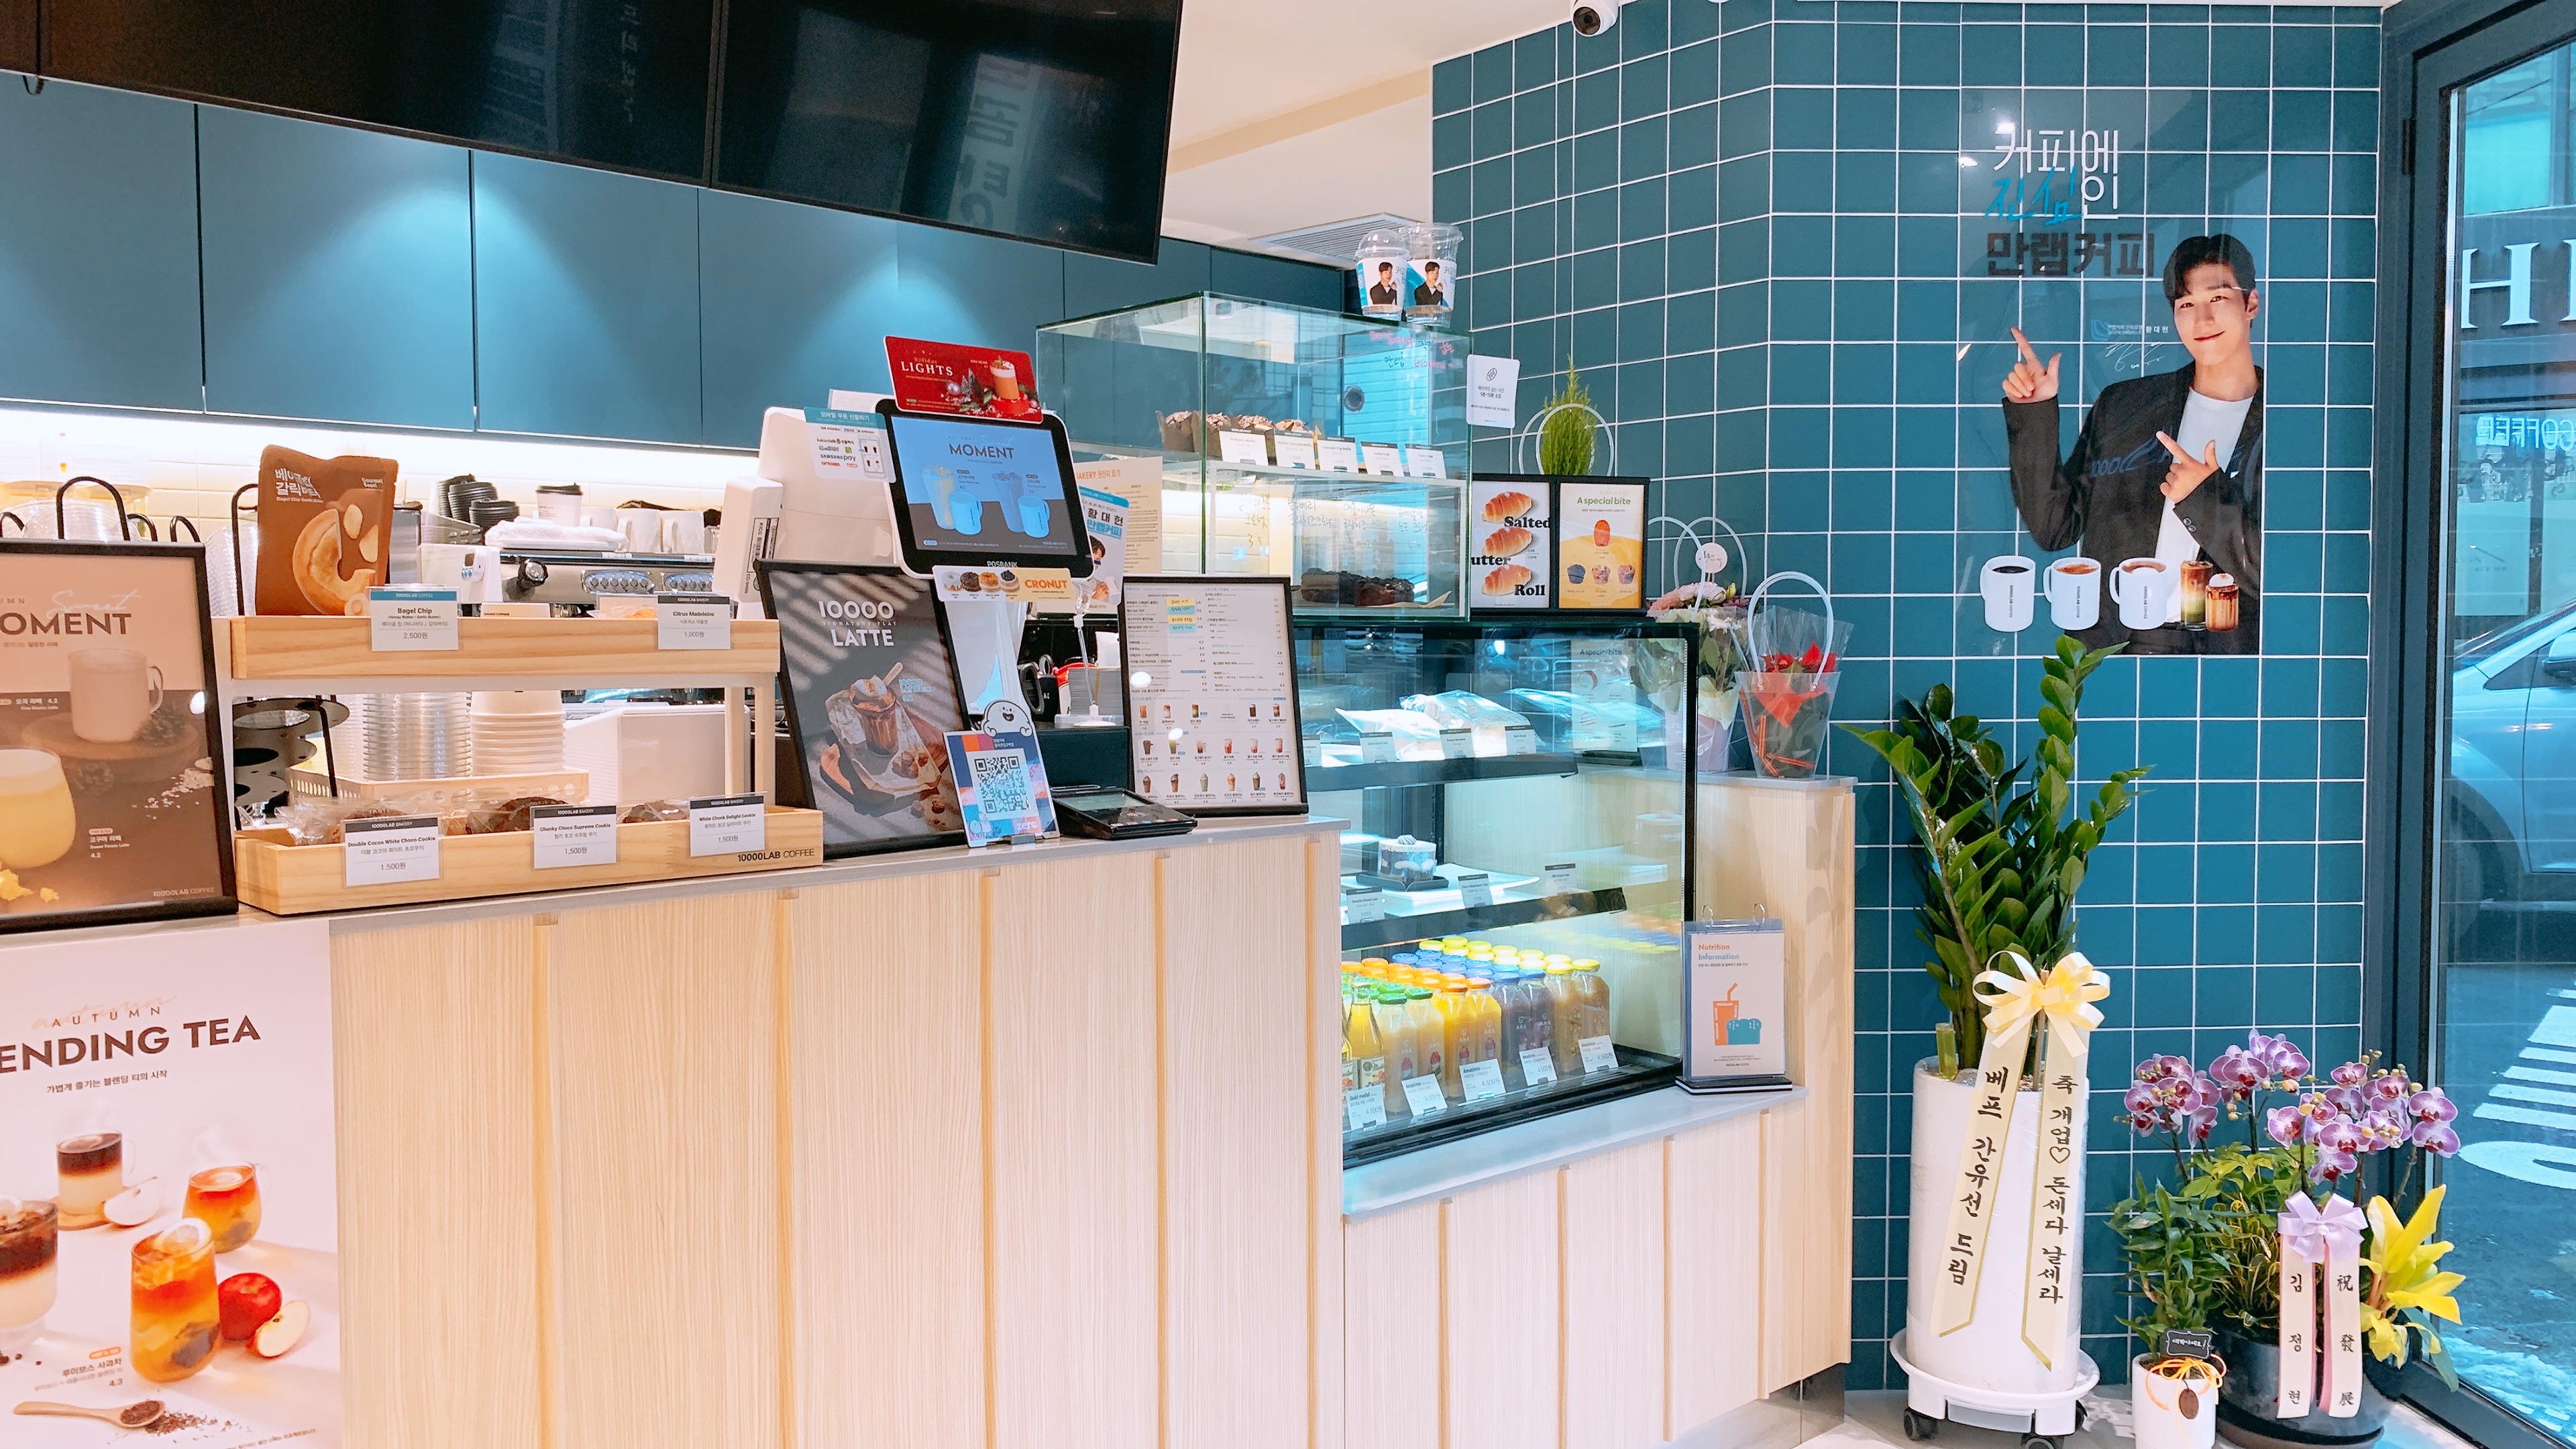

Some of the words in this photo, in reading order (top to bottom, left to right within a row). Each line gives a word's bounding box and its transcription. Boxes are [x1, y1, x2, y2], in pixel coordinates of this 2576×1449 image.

[1993, 129, 2118, 173] 커피에
[1987, 233, 2155, 277] 만랩커피
[901, 361, 953, 376] LIGHTS
[949, 443, 1014, 459] MOMENT
[1584, 497, 1613, 506] special
[1504, 517, 1550, 529] Salted
[1025, 580, 1068, 589] CRONUT
[1514, 584, 1546, 596] Roll
[818, 600, 894, 619] 10000
[0, 612, 131, 635] OMENT
[831, 629, 894, 647] LATTE
[738, 851, 781, 861] 10000LAB
[783, 849, 814, 858] COFFEE
[381, 862, 406, 871] 1,500원
[52, 1006, 160, 1028] AUTUMN
[0, 1026, 170, 1073] ENDING
[183, 1015, 262, 1049] TEA
[1597, 1053, 1613, 1061] 4,500원
[1538, 1065, 1552, 1073] 4,500원
[46, 1081, 72, 1093] 가볍게
[76, 1079, 101, 1091] 즐기는
[104, 1075, 129, 1087] 블렌딩
[131, 1072, 148, 1082] 티의
[151, 1070, 168, 1079] 시작
[1481, 1078, 1501, 1087] 4,500원
[2051, 1075, 2079, 1095] 축
[1424, 1093, 1441, 1102] 4,500원
[1366, 1106, 1383, 1115] 4,000원
[1960, 1136, 1996, 1218] 간유선
[2042, 1175, 2071, 1235] 돈세다
[1947, 1233, 1974, 1285] 드림
[2037, 1246, 2067, 1305] 날세라
[109, 1378, 123, 1386] 4.3
